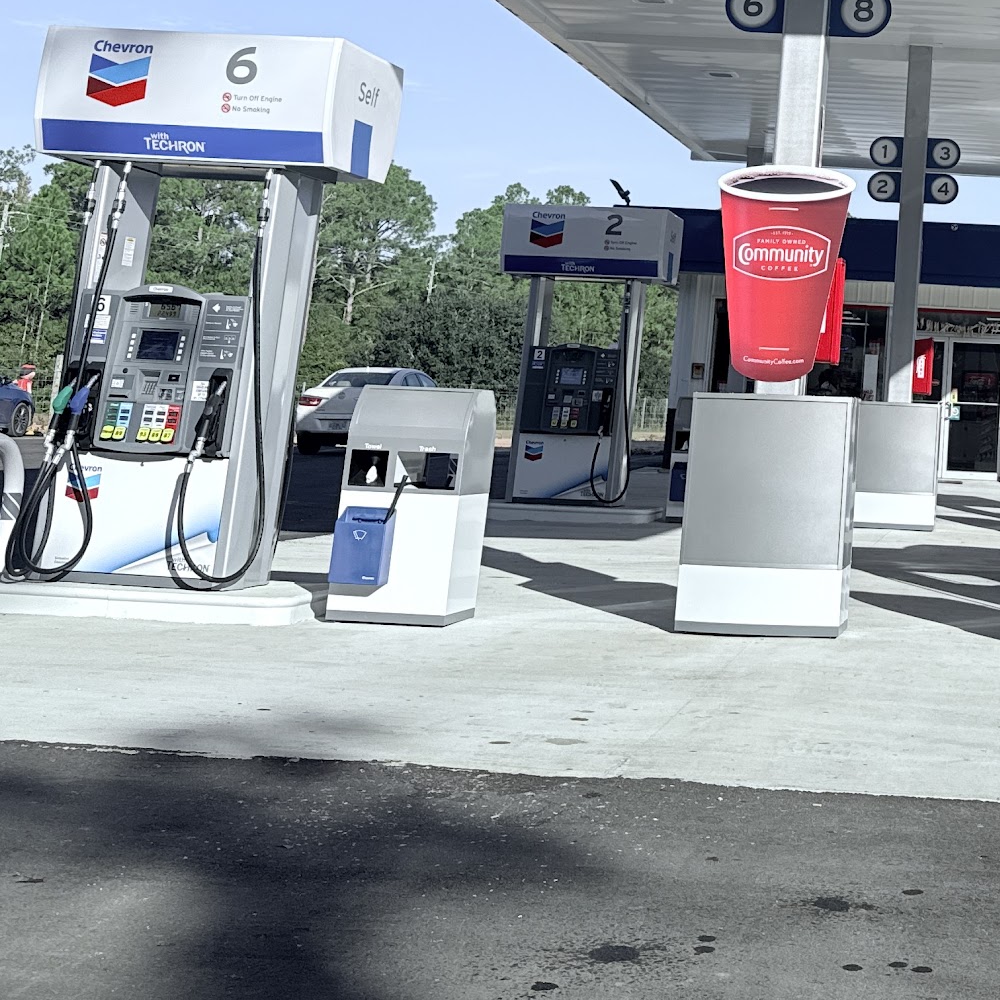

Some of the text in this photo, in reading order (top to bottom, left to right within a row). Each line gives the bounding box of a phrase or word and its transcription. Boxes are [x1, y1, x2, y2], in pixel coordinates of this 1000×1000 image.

[93, 39, 154, 55] Chevron
[225, 46, 258, 85] 6
[260, 95, 283, 103] Engine
[358, 81, 380, 108] Self
[242, 106, 271, 115] Smoking
[150, 131, 170, 140] with
[143, 136, 206, 155] TECHRON
[881, 144, 889, 158] 1
[939, 146, 951, 161] 3
[876, 179, 889, 194] 2
[937, 181, 949, 196] 4
[532, 211, 566, 220] Chevron
[605, 214, 624, 236] 2
[738, 242, 825, 267] Community
[561, 263, 595, 273] TECHRON
[97, 297, 106, 312] 6
[536, 350, 543, 359] 2
